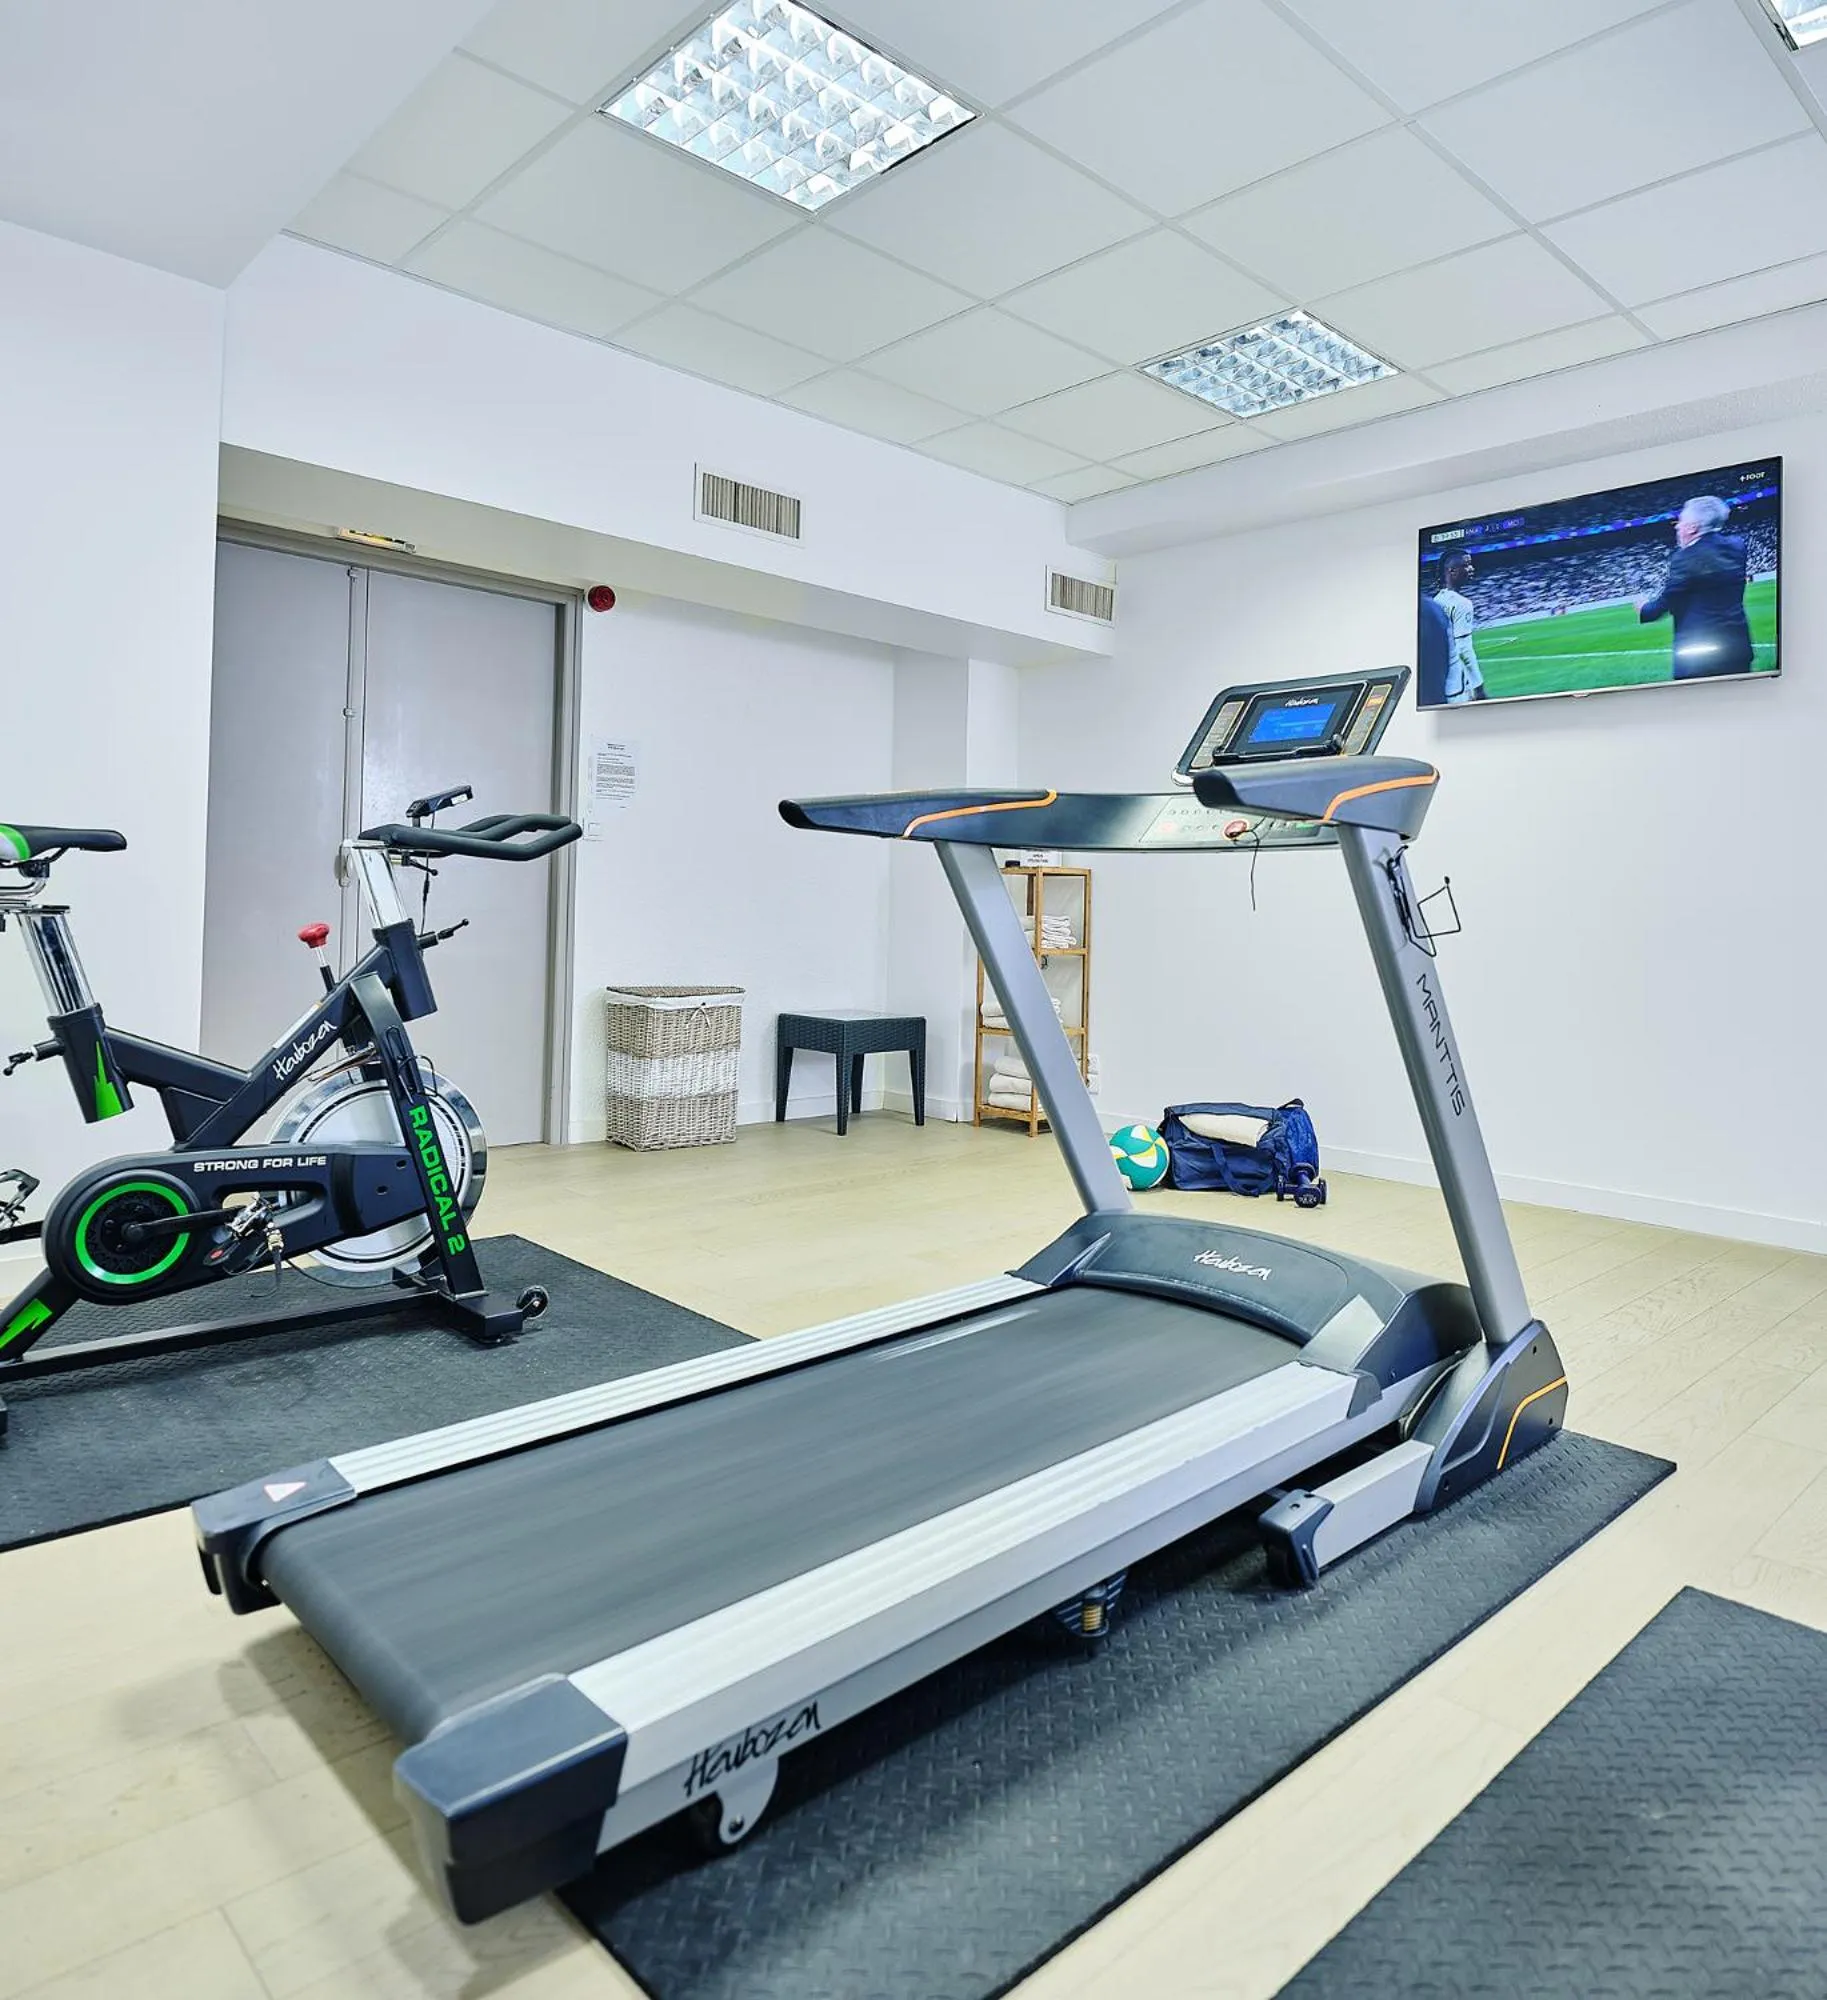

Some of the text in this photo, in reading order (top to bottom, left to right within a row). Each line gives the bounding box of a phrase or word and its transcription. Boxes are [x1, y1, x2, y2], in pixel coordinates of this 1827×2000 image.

[1416, 973, 1466, 1117] MANTTIS
[193, 1155, 328, 1173] STRONG FOR LIFE
[409, 1104, 466, 1256] RADICAL 2
